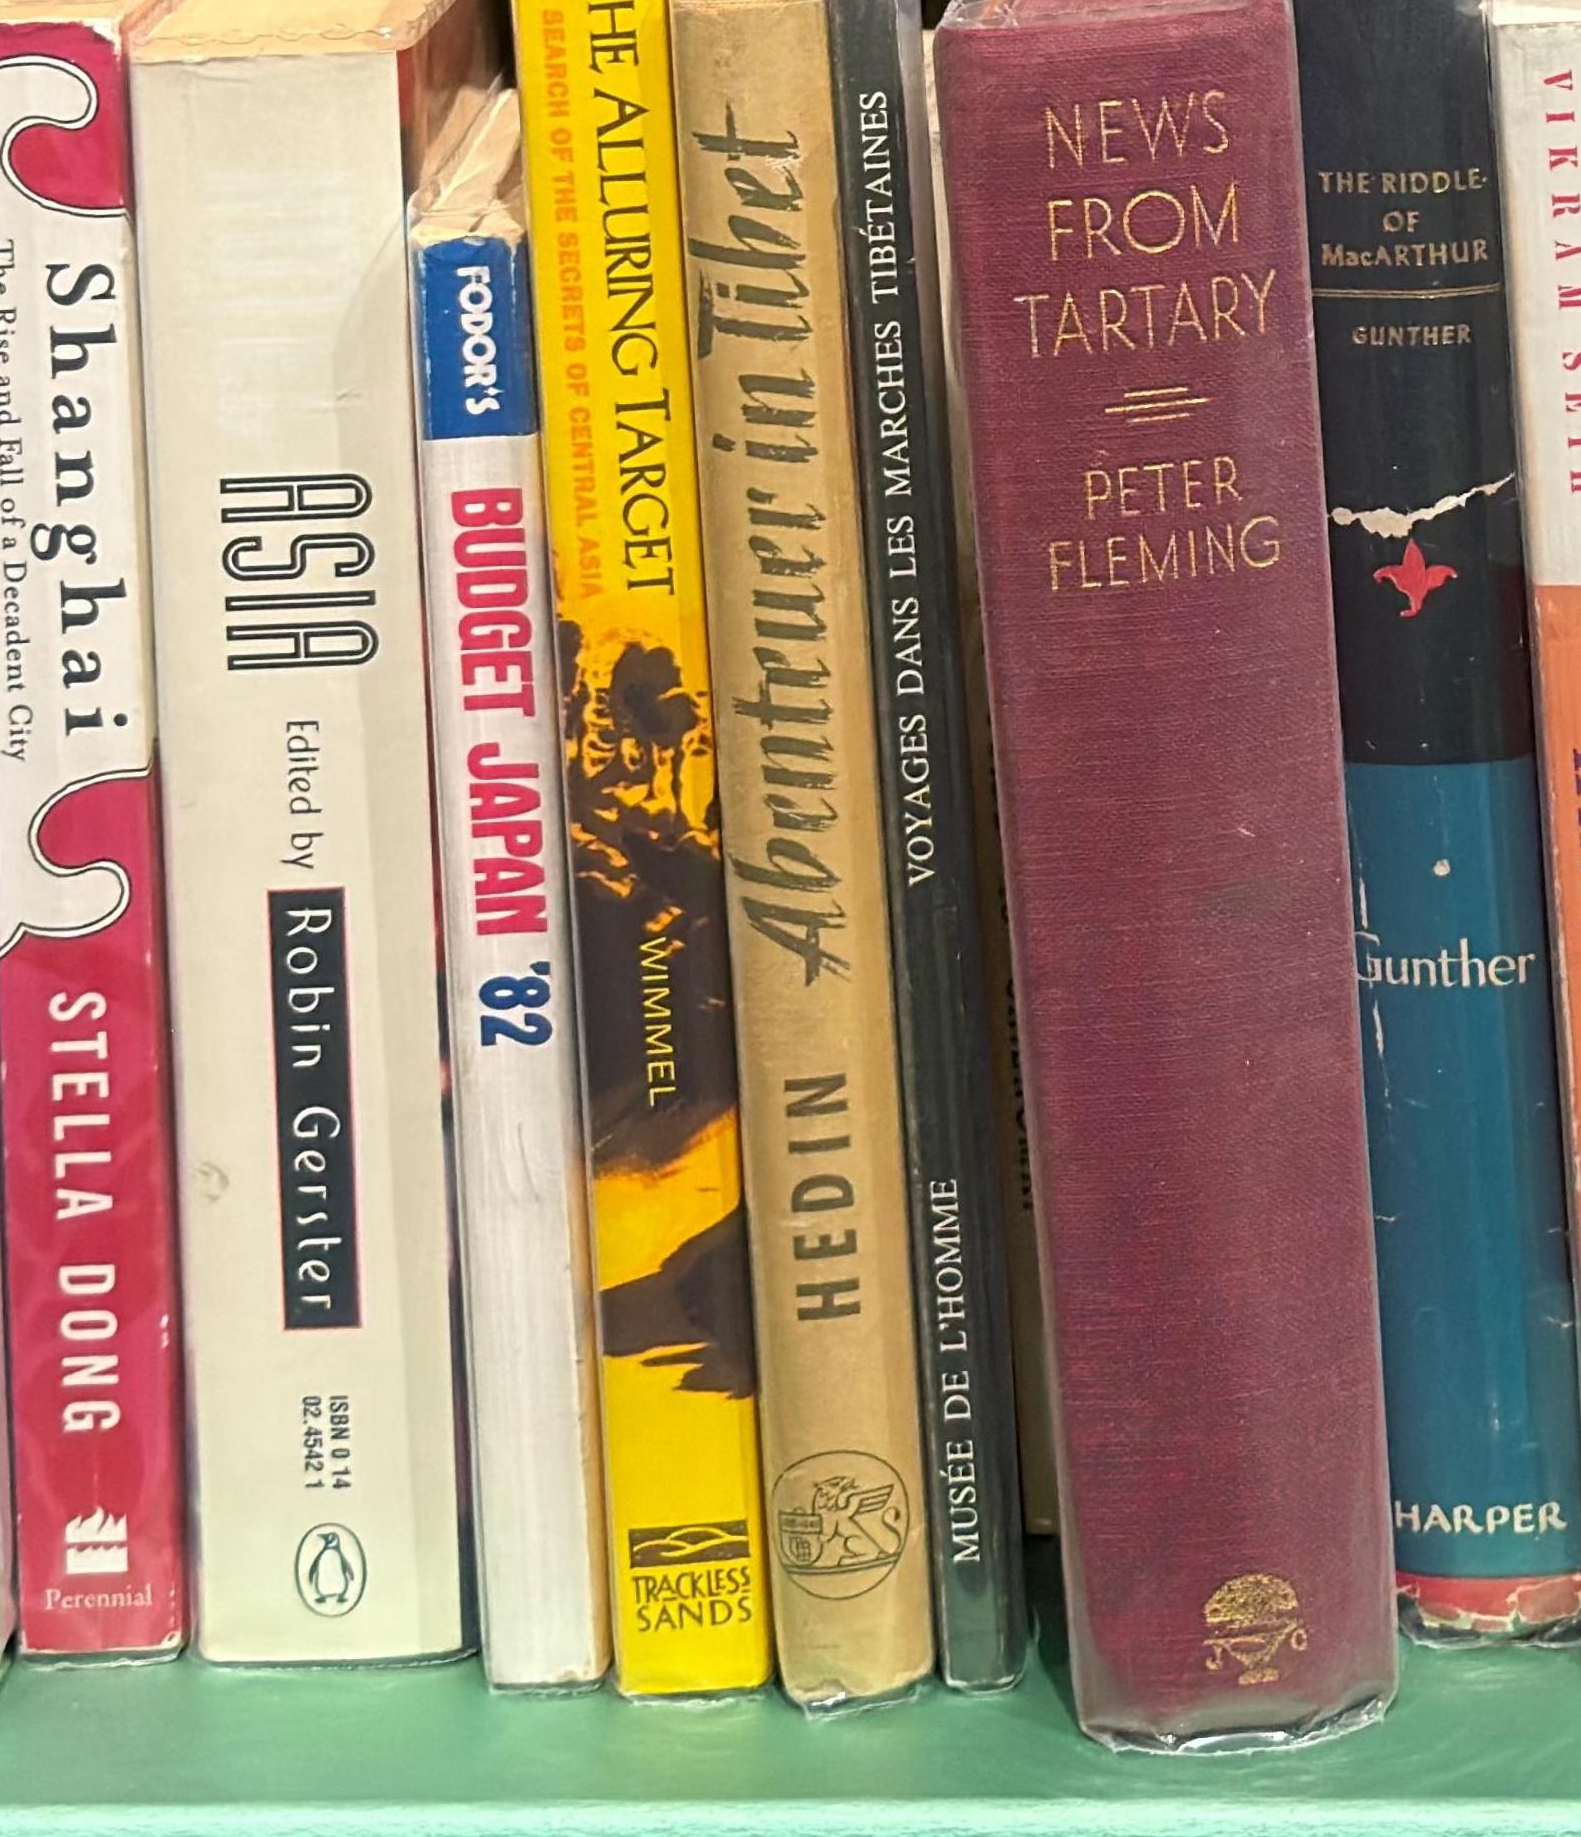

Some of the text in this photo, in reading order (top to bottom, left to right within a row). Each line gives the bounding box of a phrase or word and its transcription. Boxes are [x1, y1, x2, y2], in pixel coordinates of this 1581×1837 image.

[542, 9, 571, 118] SEARCH
[550, 127, 573, 161] OF
[551, 167, 579, 224] THE
[593, 88, 659, 376] ALLURING
[1048, 184, 1240, 261] FROM
[1383, 211, 1419, 232] OF
[557, 233, 585, 353] SECRETS
[1322, 238, 1488, 266] MacARTHUR
[1014, 269, 1276, 359] TARTARY
[565, 362, 589, 398] OF
[565, 405, 598, 527] CENTRAL
[615, 388, 675, 595] TARGET
[855, 90, 937, 887] VOYAGES DANS LES MARCHES TIBÉTAINES
[2, 496, 27, 529] of
[3, 536, 16, 549] a
[688, 100, 852, 989] Abenteuer in Tibet
[1048, 516, 1280, 590] FLEMING
[452, 487, 536, 718] BUDGET
[572, 535, 602, 600] ASIA
[4, 562, 31, 692] Decadent
[2, 705, 33, 761] City
[280, 719, 323, 871] Edited by
[466, 742, 548, 936] JAPAN
[639, 936, 676, 1108] WIMMEL
[48, 991, 120, 1433] STELLA DONG
[784, 1072, 861, 1322] HEDIN
[329, 1395, 350, 1439] ISBN
[942, 1370, 970, 1420] DE
[938, 1439, 980, 1563] MUSÉE
[45, 1585, 153, 1612] Perennial
[631, 1567, 751, 1603] TRACKLESS
